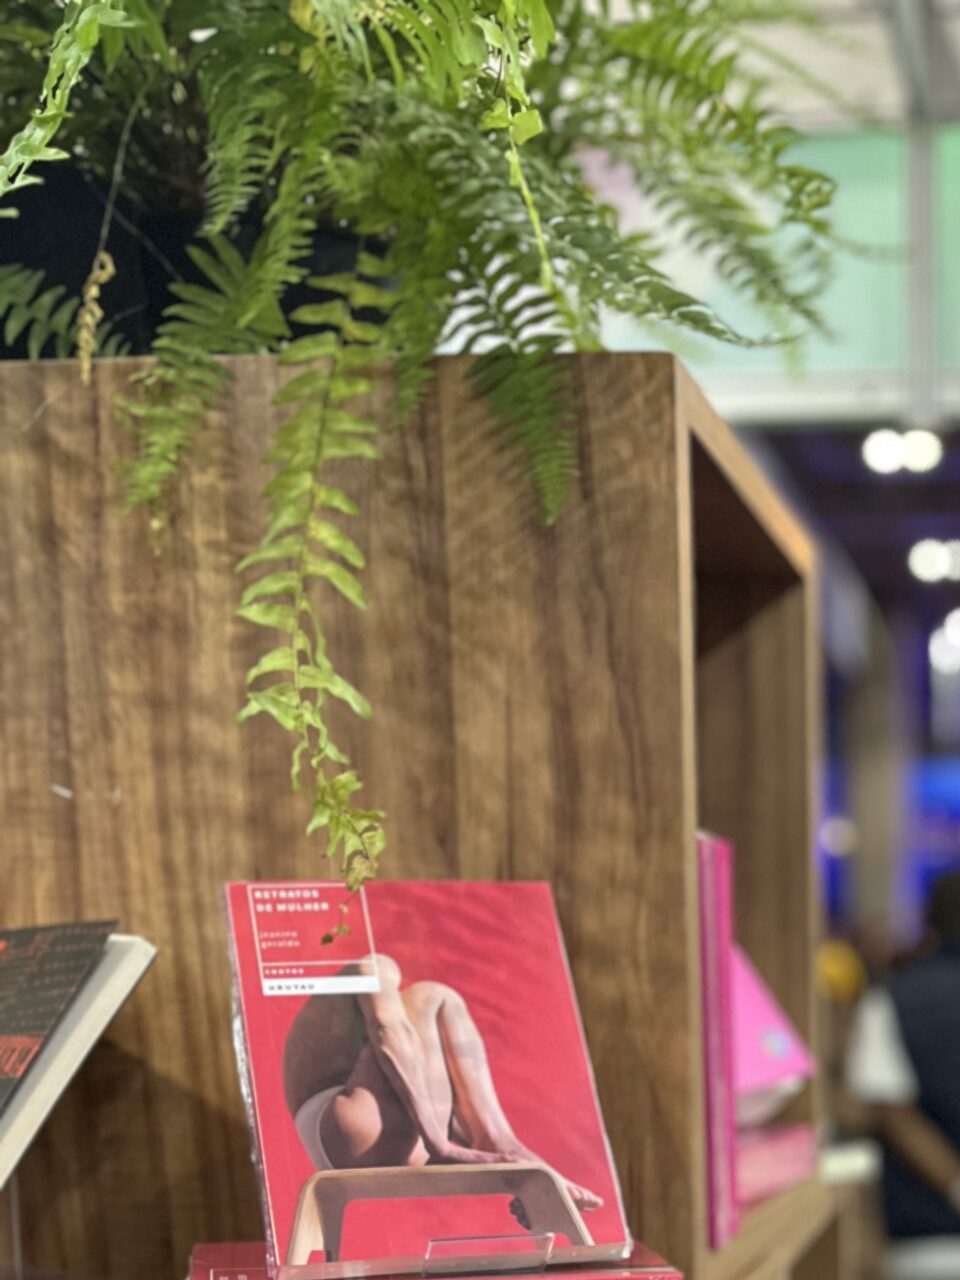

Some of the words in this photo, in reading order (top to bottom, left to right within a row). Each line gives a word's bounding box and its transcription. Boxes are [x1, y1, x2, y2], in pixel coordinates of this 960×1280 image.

[254, 889, 319, 899] RETRATOS
[256, 903, 272, 912] DE
[276, 902, 329, 912] MULHER
